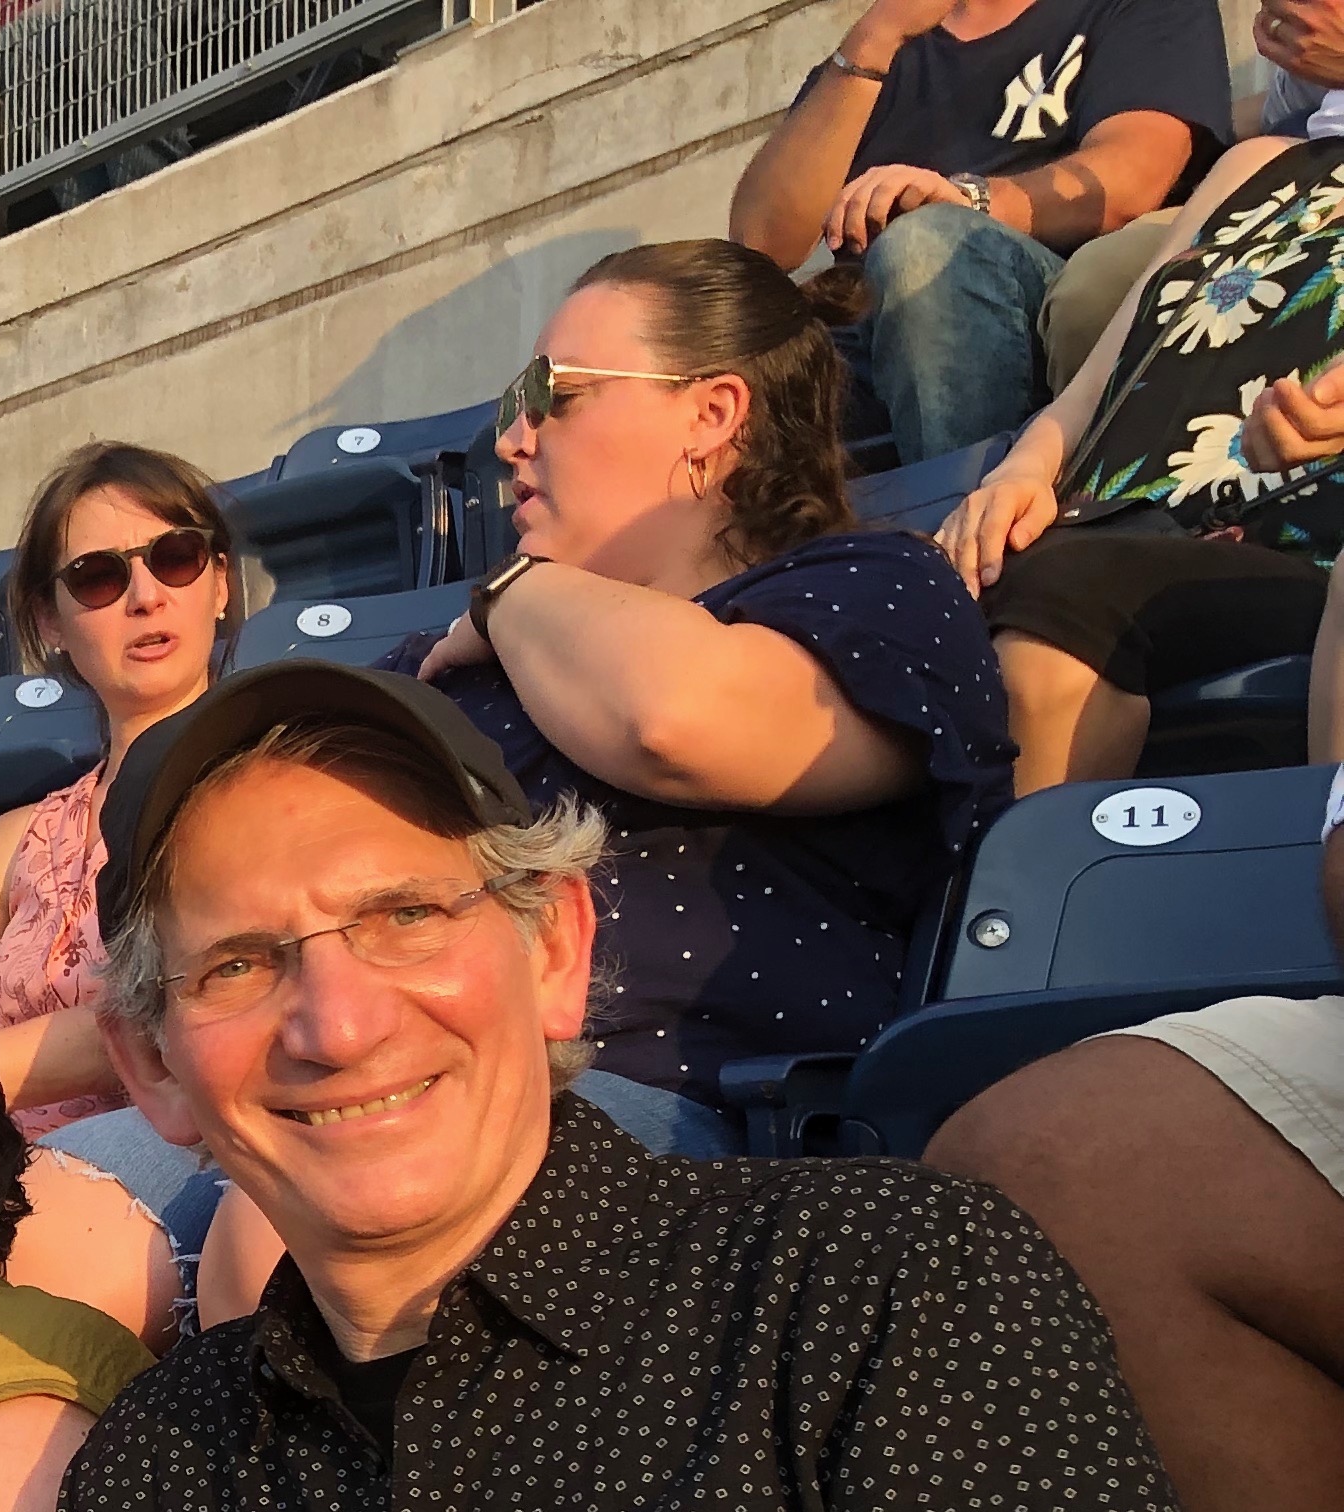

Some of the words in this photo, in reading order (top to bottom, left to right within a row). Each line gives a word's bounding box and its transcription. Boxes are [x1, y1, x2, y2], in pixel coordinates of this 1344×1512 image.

[991, 33, 1086, 142] NY
[354, 435, 366, 446] 7
[317, 613, 331, 627] 8
[34, 686, 46, 699] 7
[1122, 805, 1170, 829] 11
